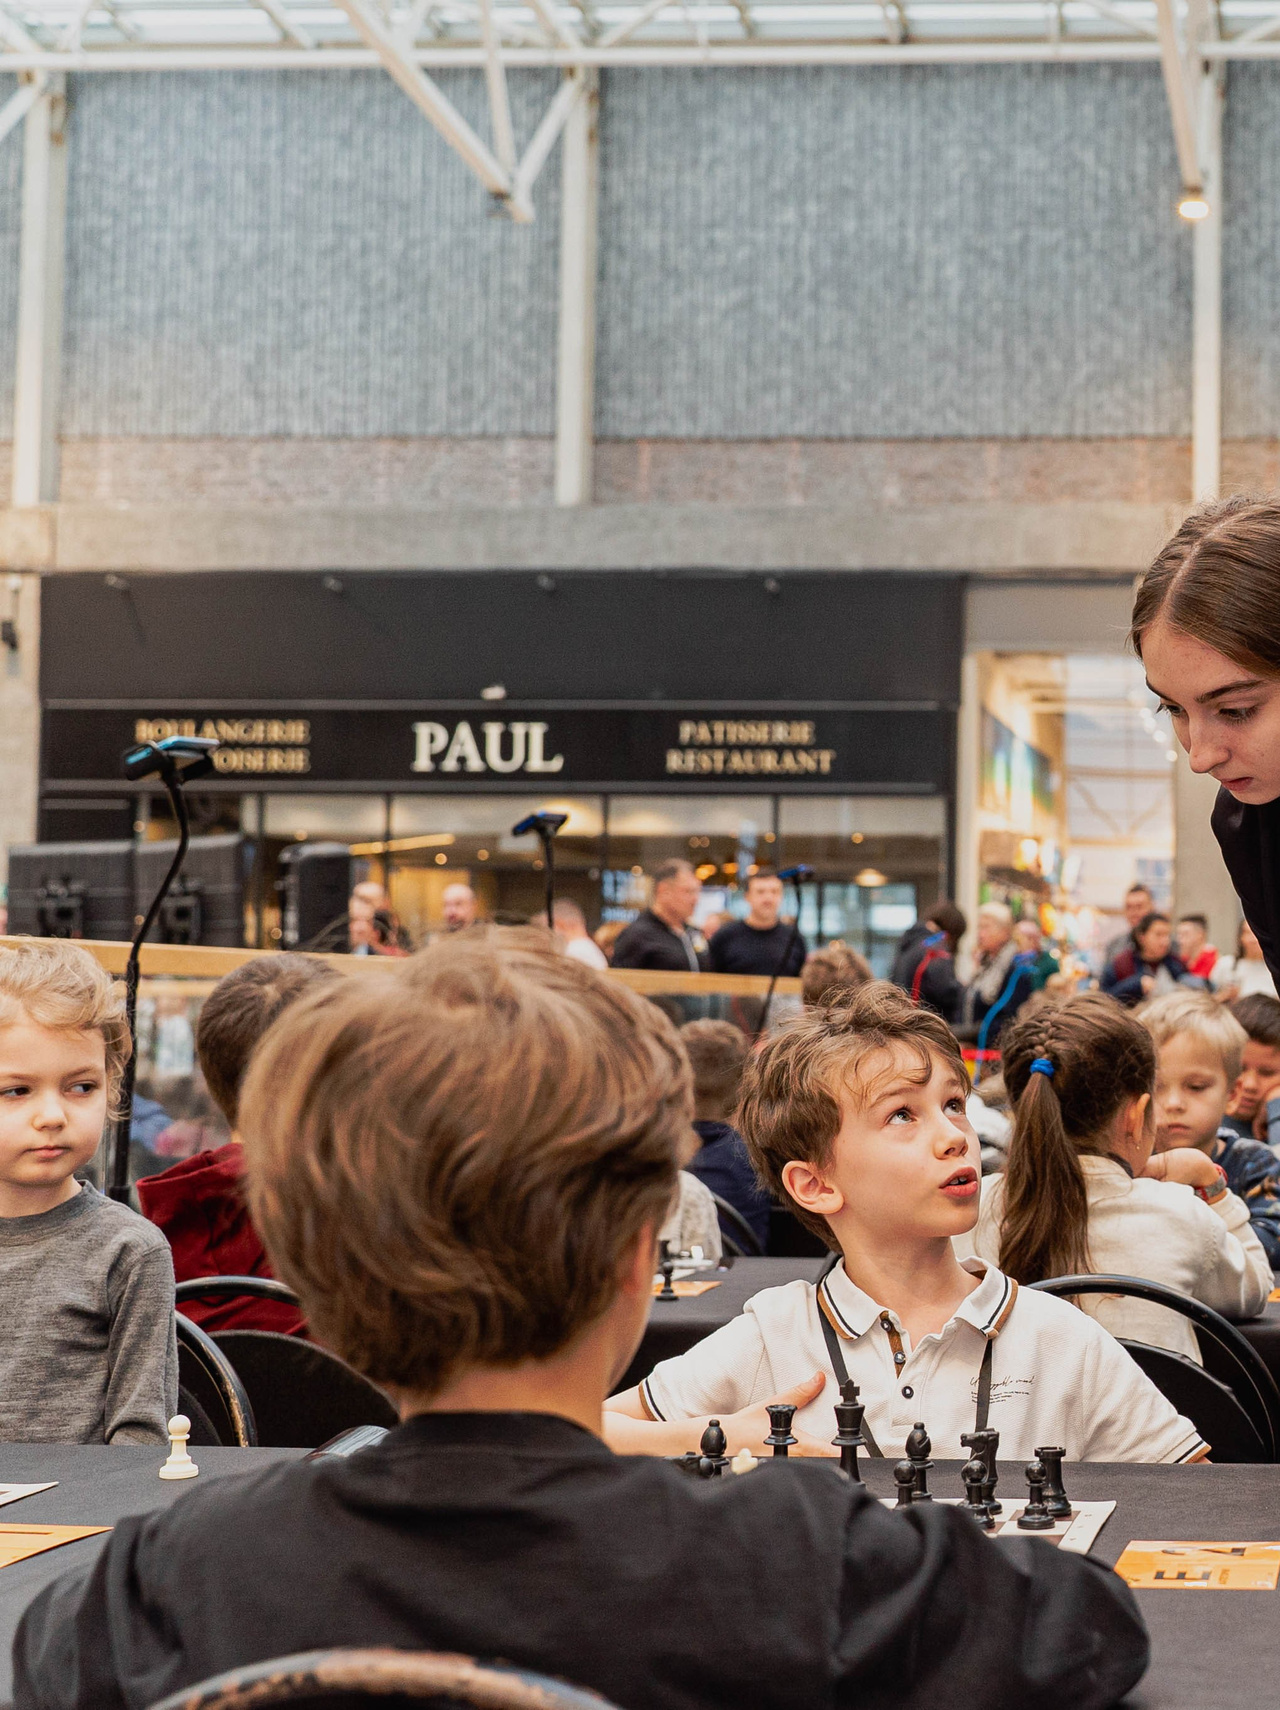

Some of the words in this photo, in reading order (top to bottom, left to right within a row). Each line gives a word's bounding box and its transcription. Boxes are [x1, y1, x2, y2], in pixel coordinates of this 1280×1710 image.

[679, 720, 815, 745] PATISSERIE
[411, 721, 564, 773] PAUL
[666, 749, 836, 774] RESTAURANT
